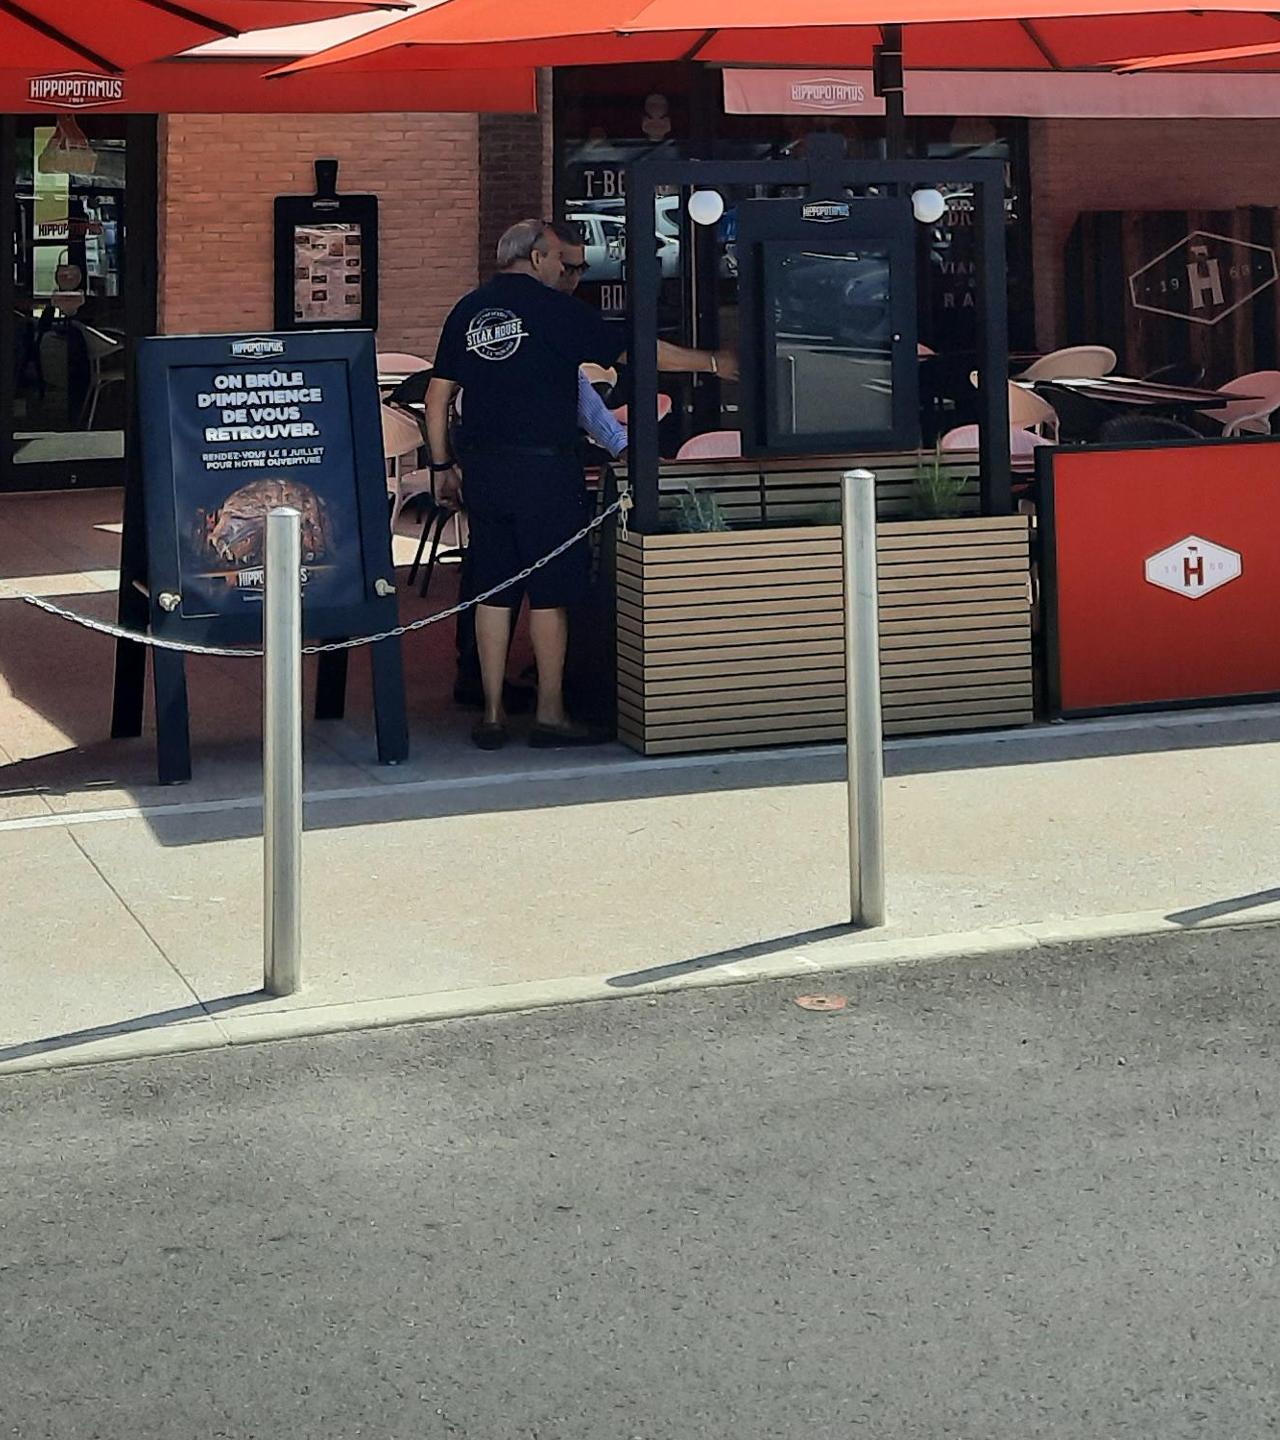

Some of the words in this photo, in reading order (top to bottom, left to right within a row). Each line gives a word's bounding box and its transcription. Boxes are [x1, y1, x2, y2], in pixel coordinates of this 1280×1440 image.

[30, 79, 123, 99] HIPPOPOTAMUS
[791, 84, 865, 102] HIPPOPOTAMUS
[1186, 258, 1224, 309] H
[466, 327, 494, 347] STEAK
[494, 320, 523, 340] HOUSE
[214, 375, 242, 389] ON
[245, 370, 304, 388] BRÛLE
[197, 388, 323, 407] D'IMPATIENCE
[222, 409, 248, 424] DE
[250, 406, 301, 422] VOUS
[205, 423, 320, 442] RETROUVER.
[202, 449, 266, 462] RENDEZ-VOUS
[269, 448, 280, 458] LE
[289, 446, 324, 457] JUILLET
[206, 460, 232, 470] POUR
[234, 458, 265, 469] NOTRE
[267, 455, 322, 467] OUVERTURE
[1183, 555, 1204, 587] H
